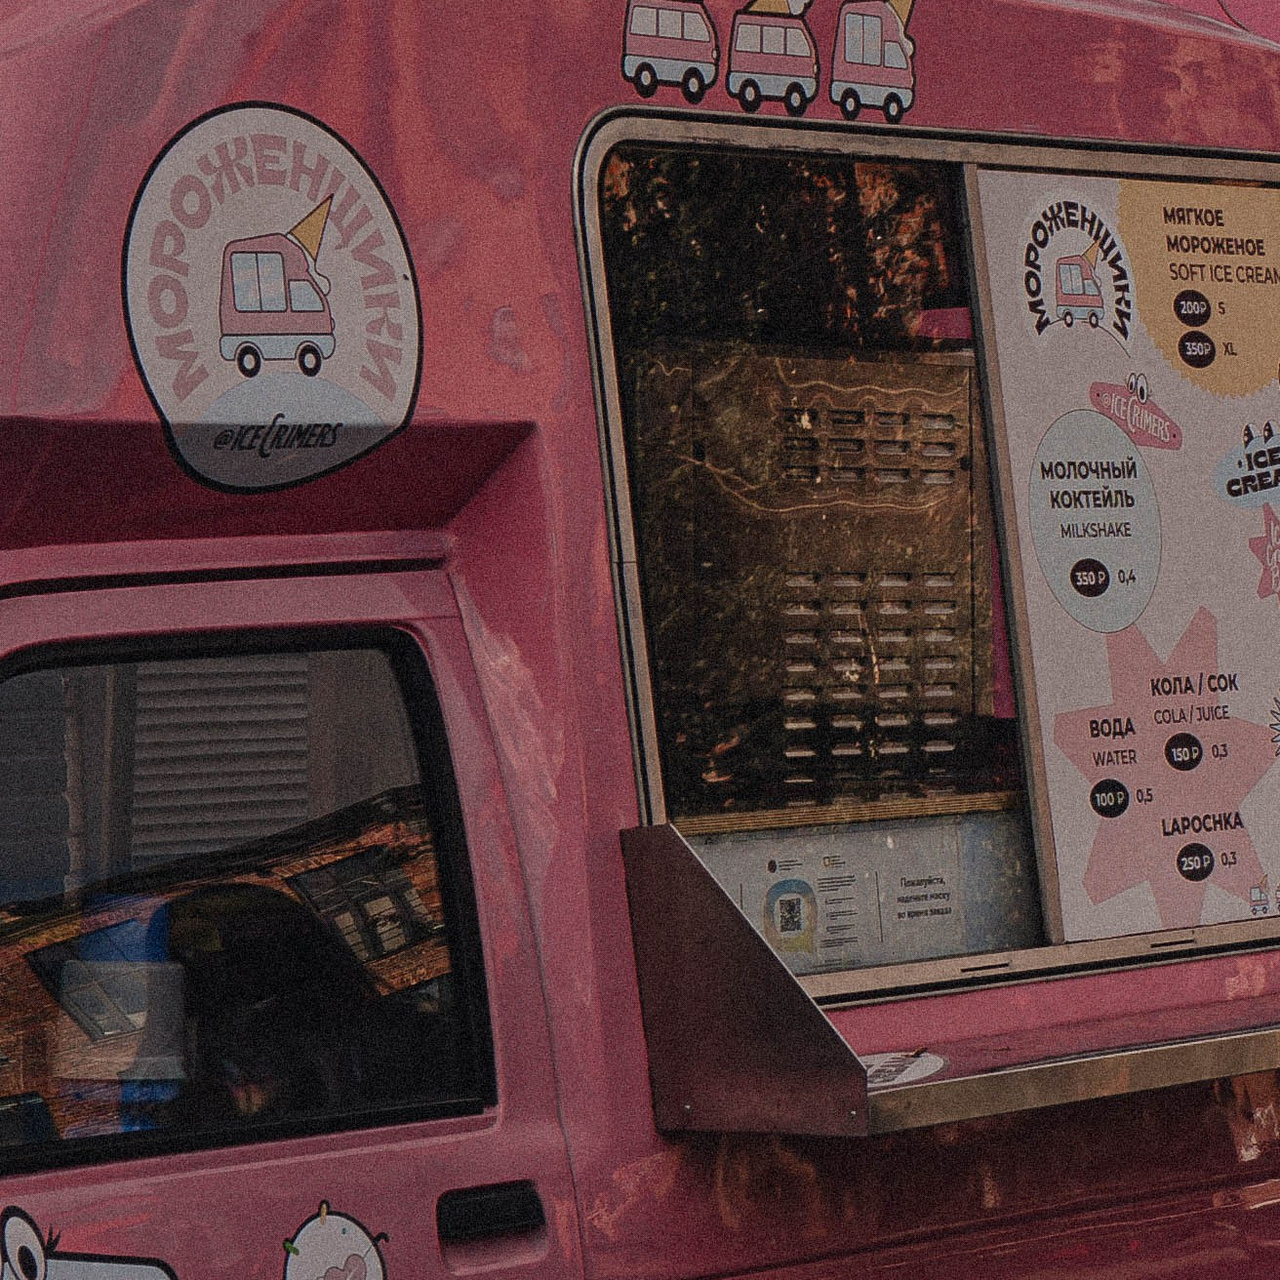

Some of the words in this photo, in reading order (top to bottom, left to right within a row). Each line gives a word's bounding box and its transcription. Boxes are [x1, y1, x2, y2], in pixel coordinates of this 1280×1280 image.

[1163, 206, 1225, 227] МЯГКОЕ
[1166, 234, 1266, 257] МОРОЖЕНОЕ
[146, 132, 401, 403] МОРОЖЕНЩИКИ
[1024, 200, 1132, 341] МОРОЖЕНЩИКИ
[1169, 262, 1206, 282] SOFT
[1210, 263, 1234, 283] ICE
[1218, 301, 1226, 315] S
[1222, 341, 1238, 356] XL
[1102, 392, 1171, 443] @ICECRIMERS
[213, 412, 344, 459] @ICECRIMERS
[1040, 456, 1138, 480] МОЛОЧНЫЙ
[1049, 484, 1135, 509] КОКТЕЙЛЬ
[1060, 521, 1132, 539] MILKSHAKE
[1075, 571, 1096, 586] 350
[1117, 568, 1137, 586] 0,4
[1150, 676, 1196, 697] КОЛА
[1207, 673, 1240, 693] СОК
[1153, 707, 1186, 725] COLA
[1196, 704, 1231, 722] JUICE
[1089, 718, 1137, 740] ВОДА
[1092, 749, 1138, 767] WATER
[1171, 747, 1190, 762] 150
[1095, 793, 1115, 807] 100
[1161, 811, 1245, 837] LAPOCHKA
[1181, 856, 1201, 871] 250
